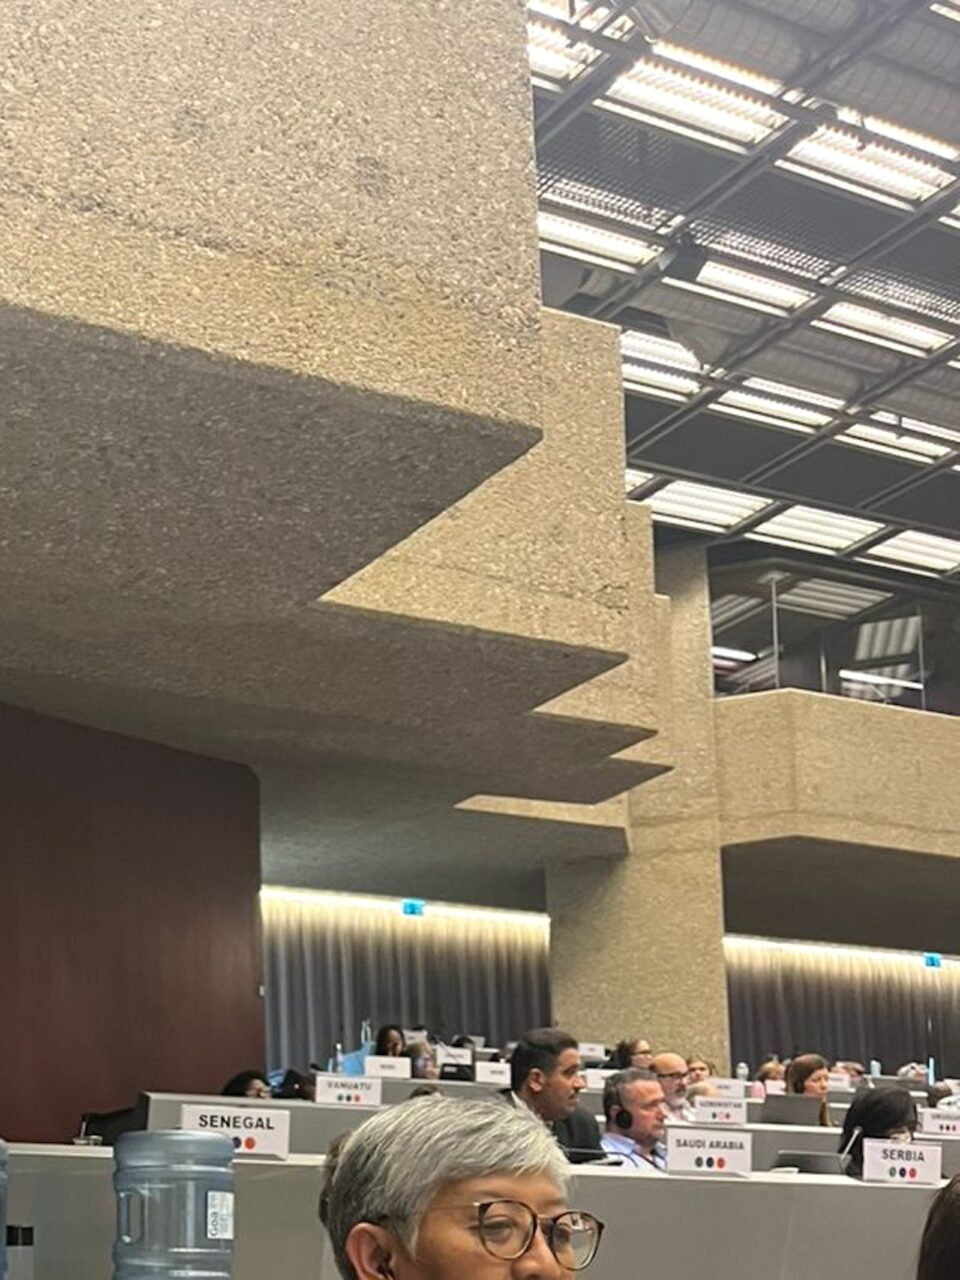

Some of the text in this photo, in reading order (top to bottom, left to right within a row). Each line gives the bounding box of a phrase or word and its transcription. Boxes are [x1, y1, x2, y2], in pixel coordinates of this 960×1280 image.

[198, 1113, 275, 1131] SENEGAL
[675, 1138, 745, 1150] SAUDI ARABIA
[882, 1148, 925, 1162] SERBIA
